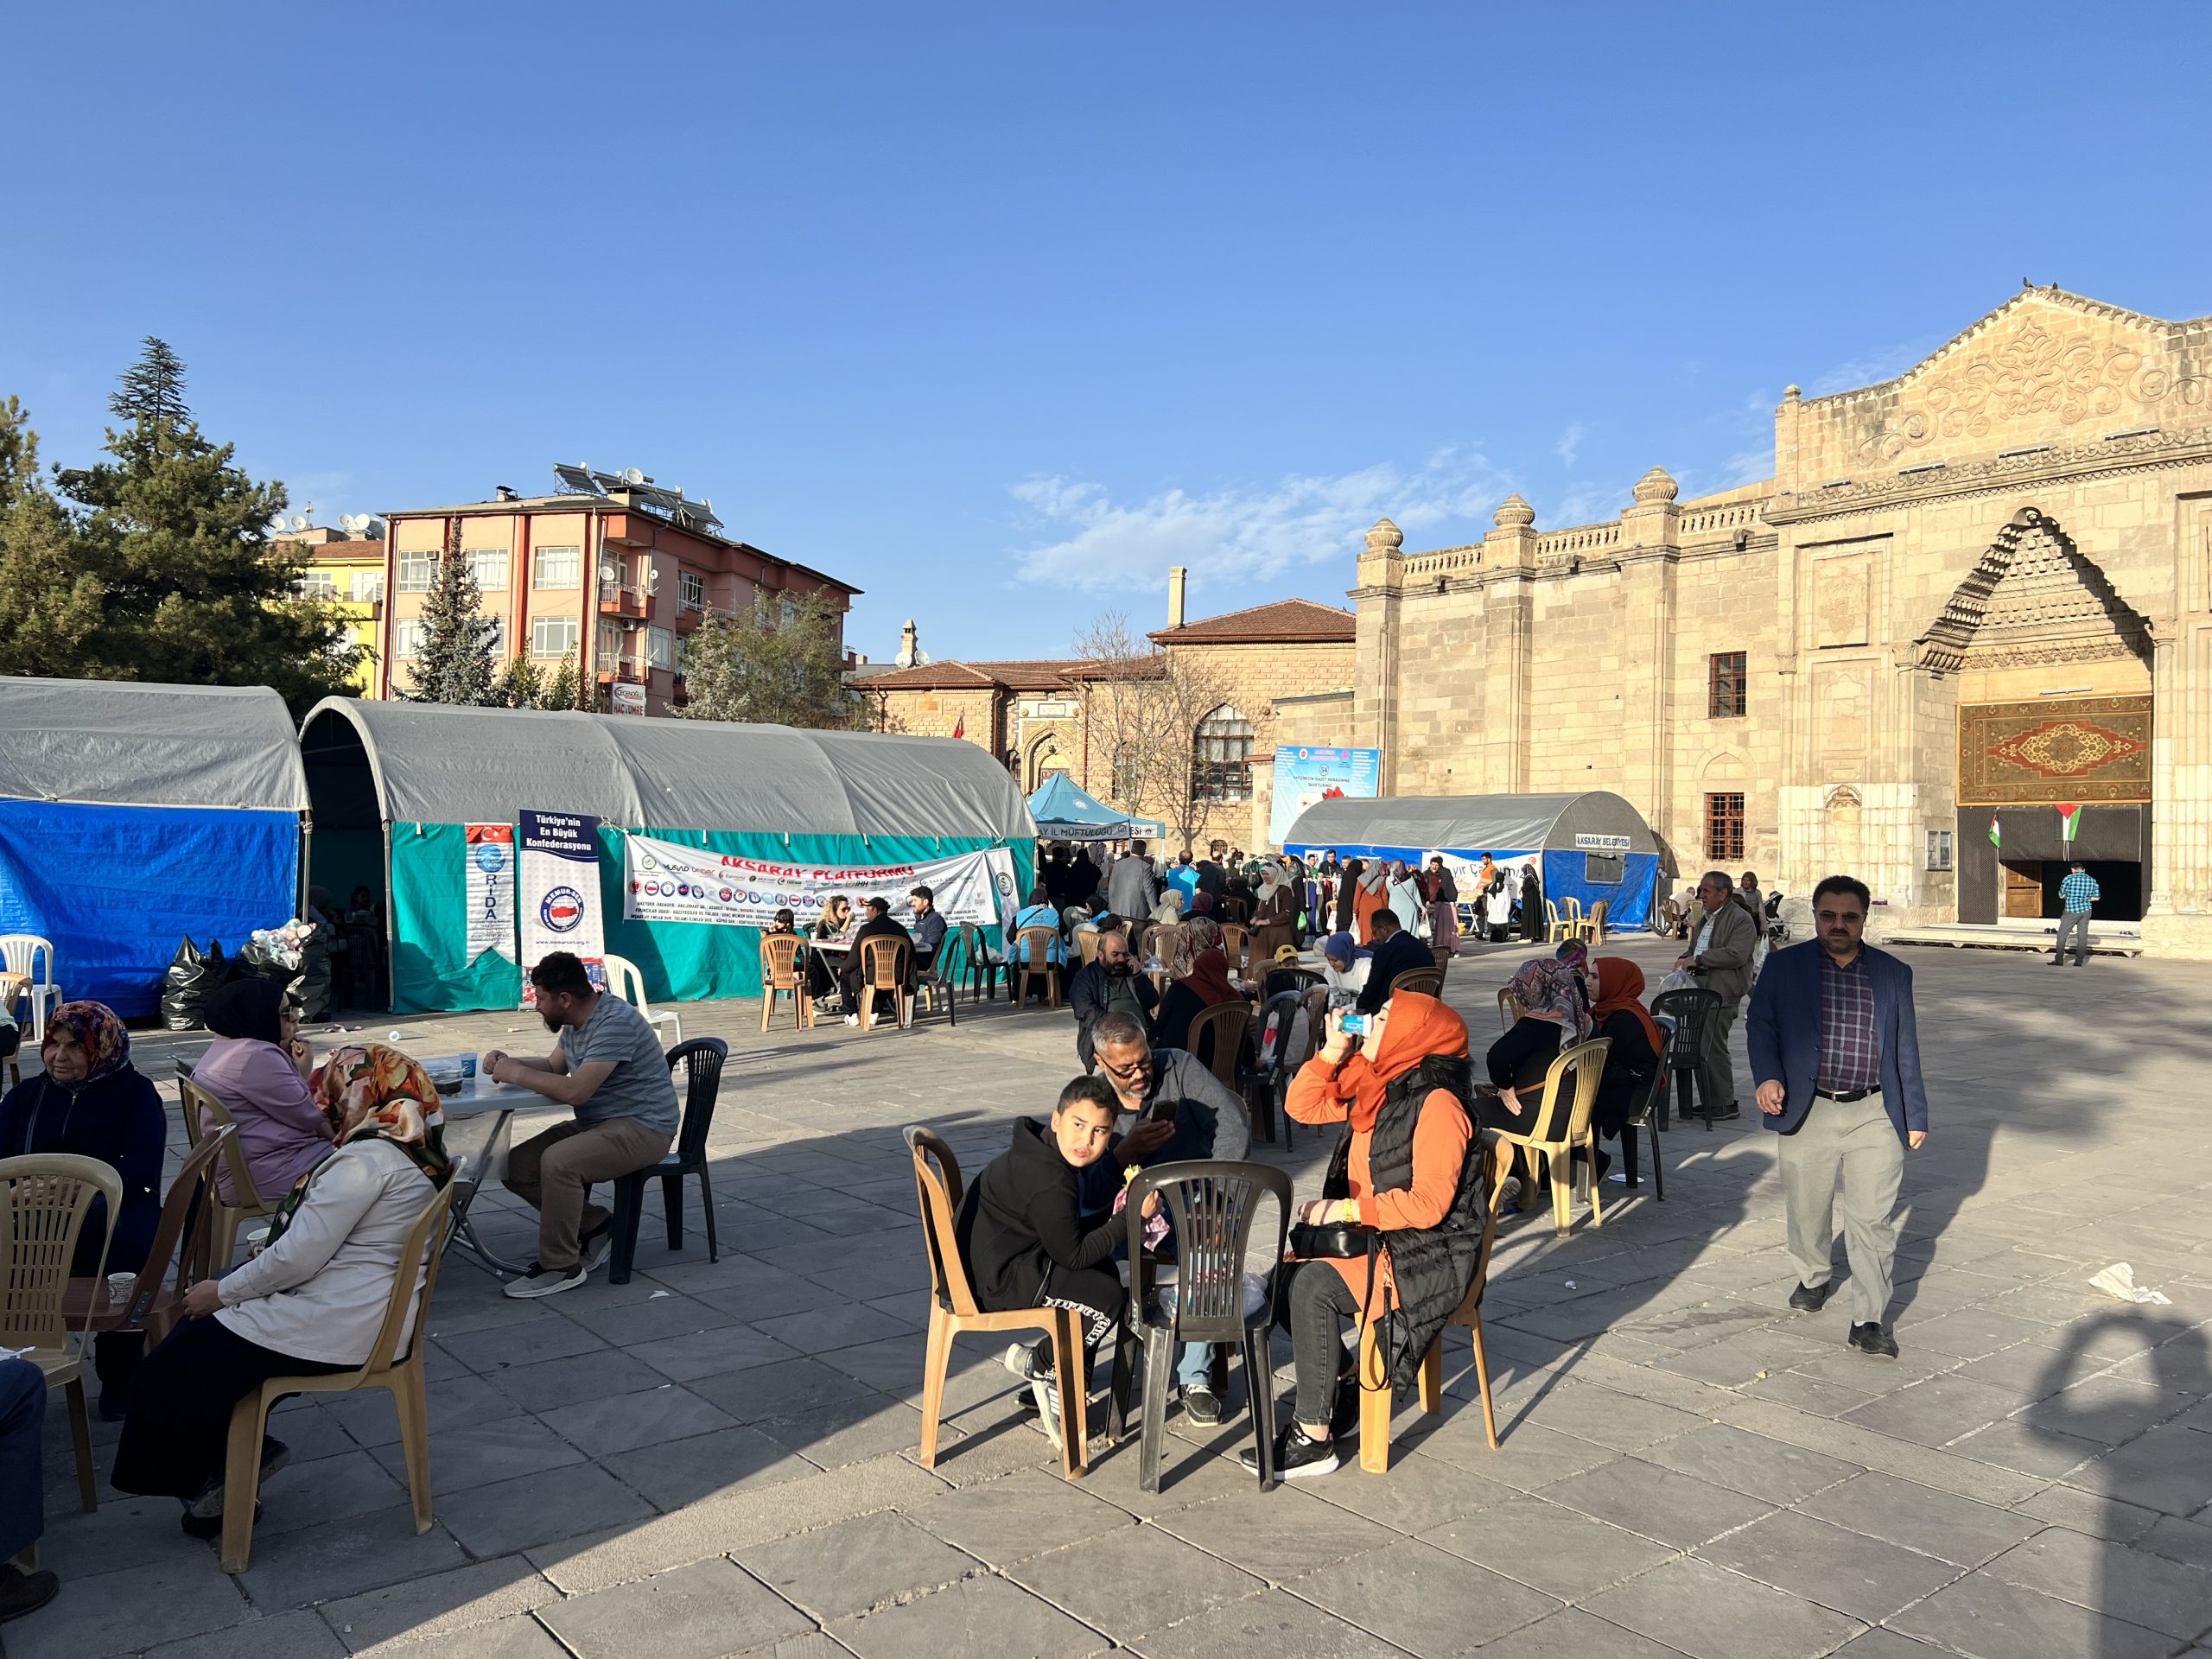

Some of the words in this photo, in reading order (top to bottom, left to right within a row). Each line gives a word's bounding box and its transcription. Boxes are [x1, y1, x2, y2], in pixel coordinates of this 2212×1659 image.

[628, 705, 644, 715] UMRE
[536, 814, 581, 827] Türkiye'nin
[540, 827, 550, 836] En
[552, 829, 578, 838] Büyük
[1051, 826, 1058, 836] İL
[526, 838, 592, 851] Konfederasyonu
[1577, 836, 1601, 845] AKSARAY
[813, 865, 915, 880] PLATFORMU
[544, 887, 582, 905] MEMUR-SEN
